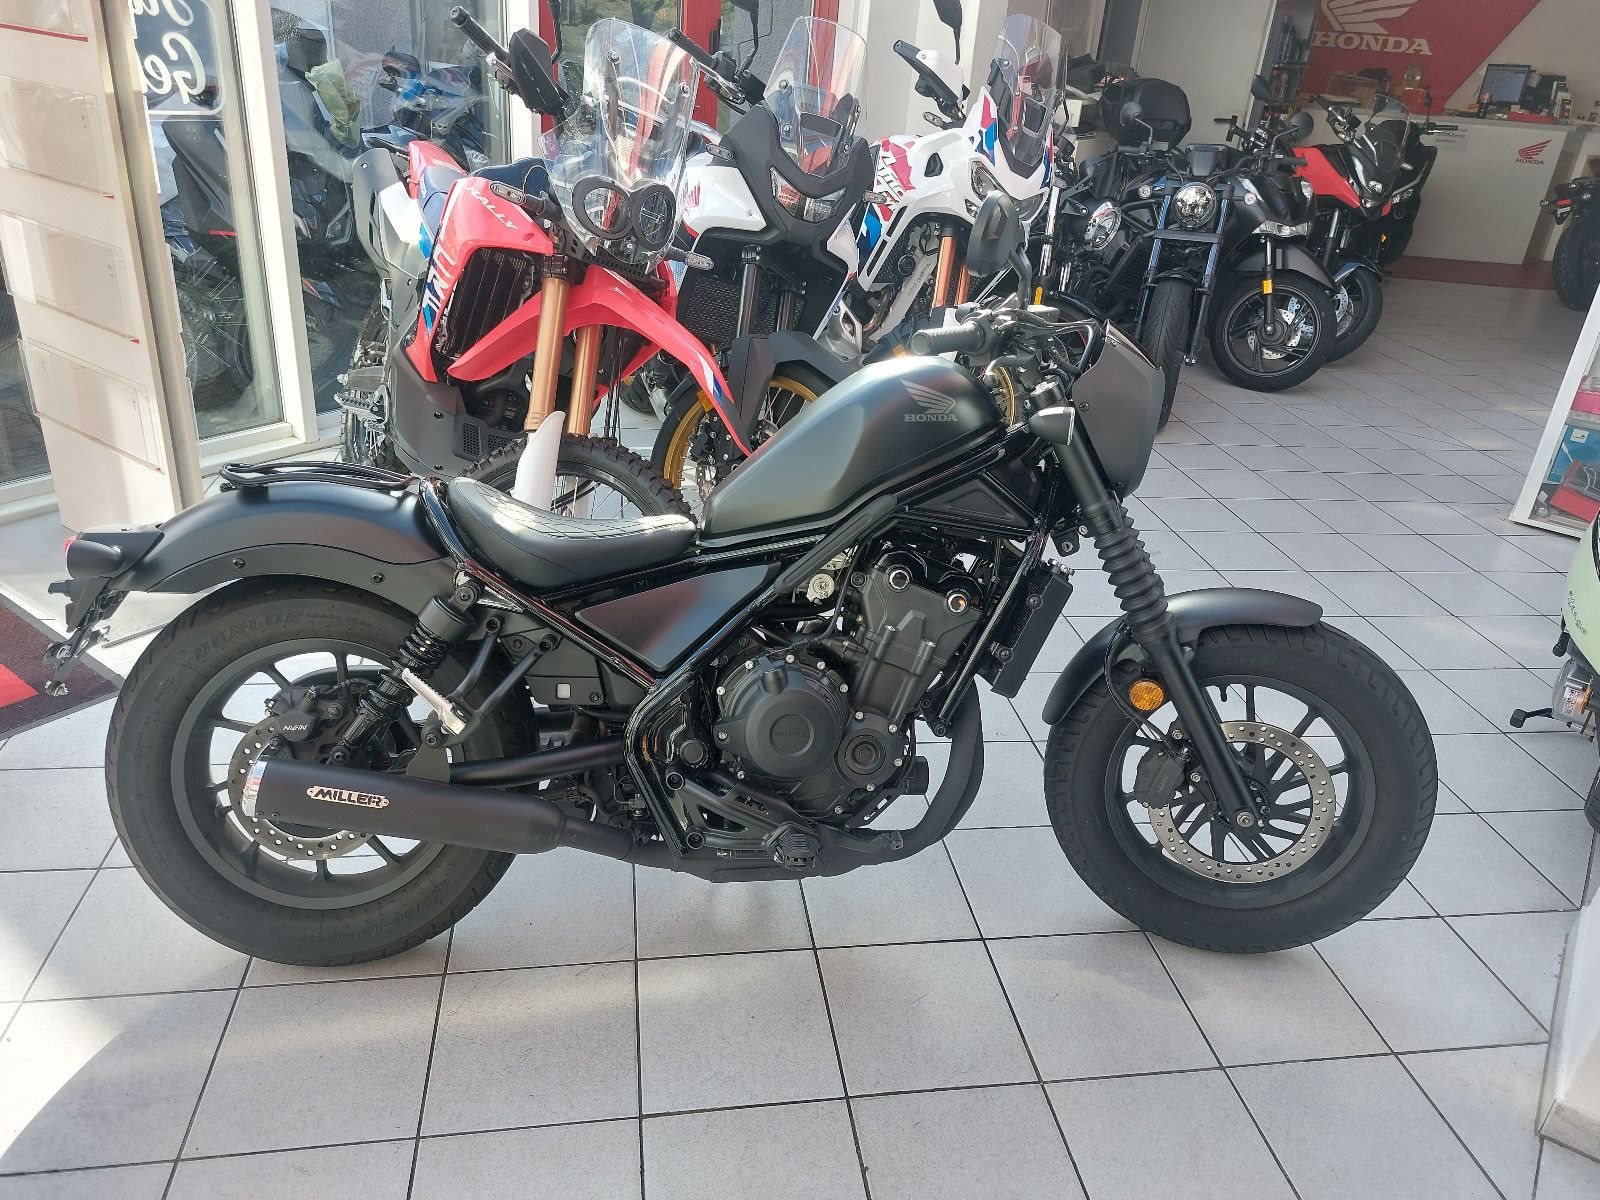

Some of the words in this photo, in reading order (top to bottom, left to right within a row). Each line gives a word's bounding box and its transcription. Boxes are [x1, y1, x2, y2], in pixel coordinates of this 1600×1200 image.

[1311, 31, 1433, 56] HONDA
[1515, 157, 1545, 165] HONDA
[466, 187, 520, 230] RALLY
[903, 413, 960, 422] HONDA
[313, 788, 382, 808] MILLER
